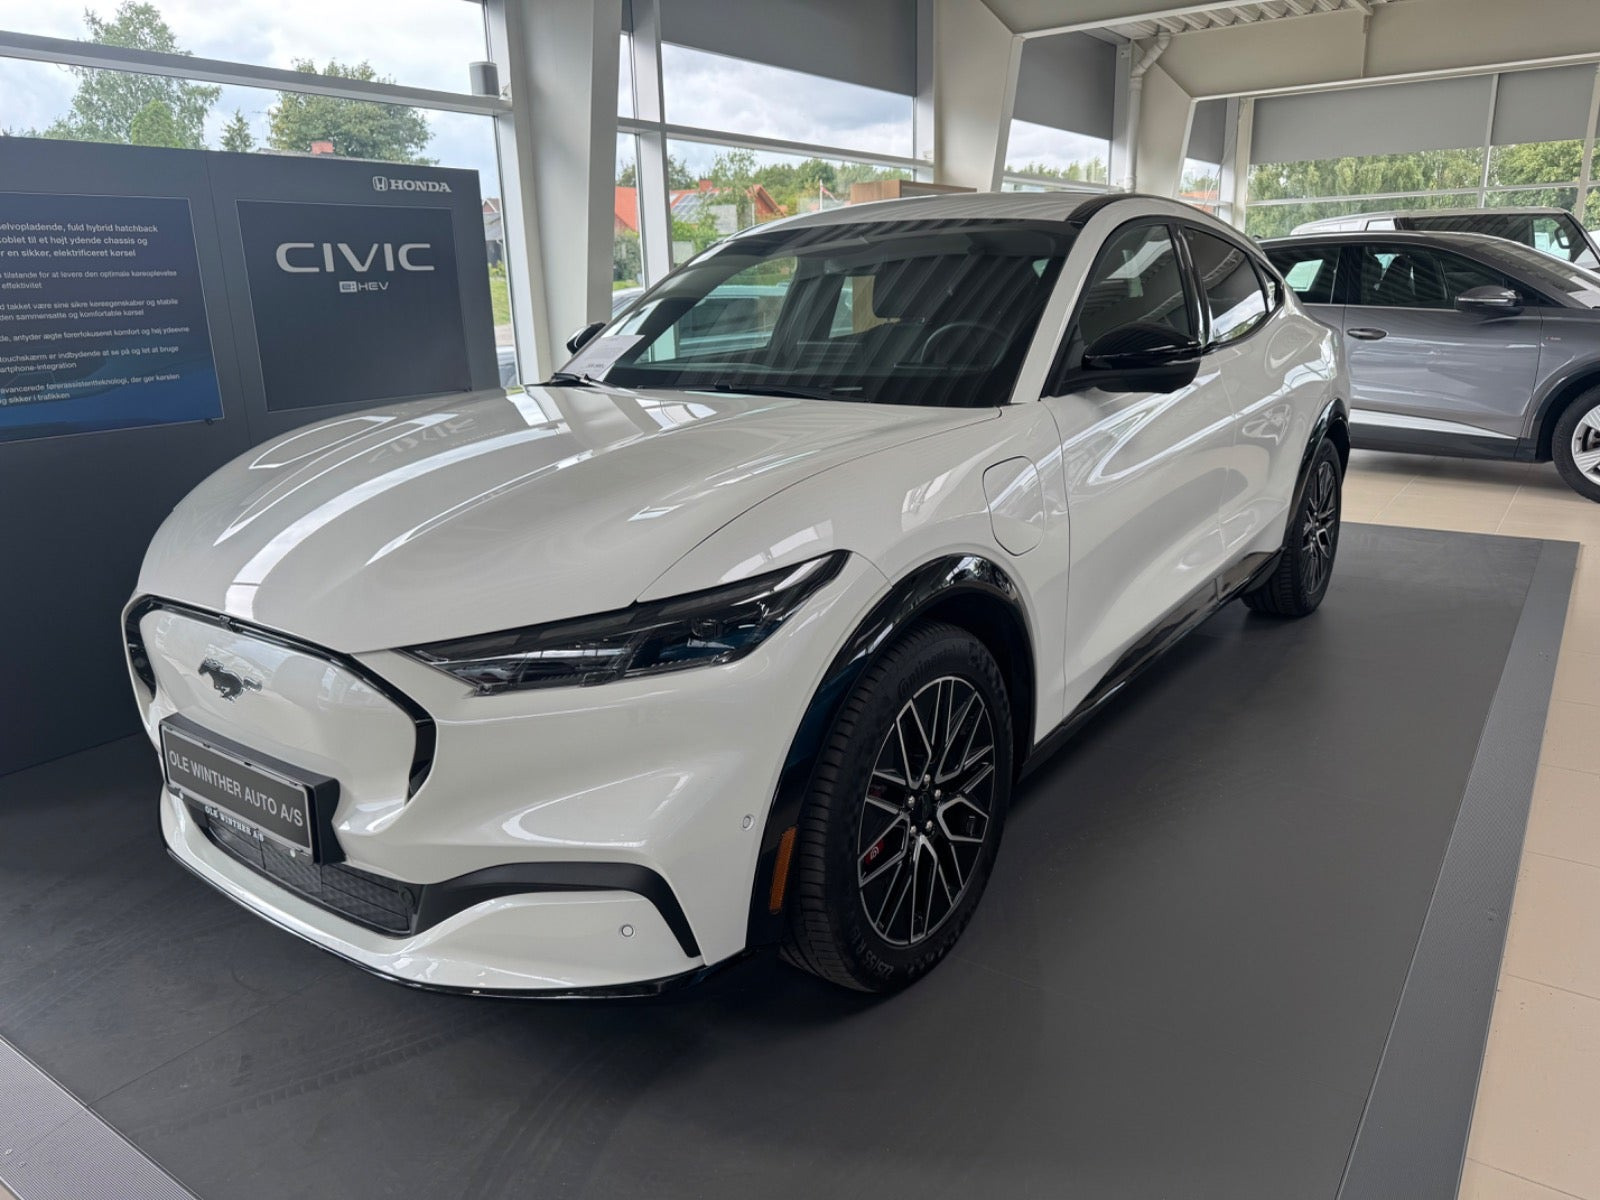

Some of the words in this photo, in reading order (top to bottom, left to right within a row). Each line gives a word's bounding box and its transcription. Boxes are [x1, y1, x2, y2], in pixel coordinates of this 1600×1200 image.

[390, 179, 452, 193] HONDA
[67, 223, 84, 232] fuld
[86, 223, 113, 233] hybrid
[115, 224, 158, 233] hatchback
[28, 236, 36, 244] til
[39, 236, 49, 244] et
[50, 236, 68, 245] højt
[70, 236, 102, 245] ydende
[137, 238, 148, 246] og
[21, 249, 51, 257] sikker,
[53, 248, 108, 256] elektrificeret
[110, 249, 136, 257] kørsel
[275, 242, 435, 273] CIVIC
[7, 302, 31, 310] takket
[15, 312, 67, 320] sammensatte
[80, 310, 122, 318] komfortable
[58, 350, 100, 359] indbydende
[121, 348, 129, 356] på
[131, 348, 140, 356] og
[8, 395, 32, 403] sikker
[169, 750, 190, 773] OLE
[190, 760, 242, 800] WINTHER
[244, 788, 278, 815] AUTO
[280, 802, 303, 828] A/S
